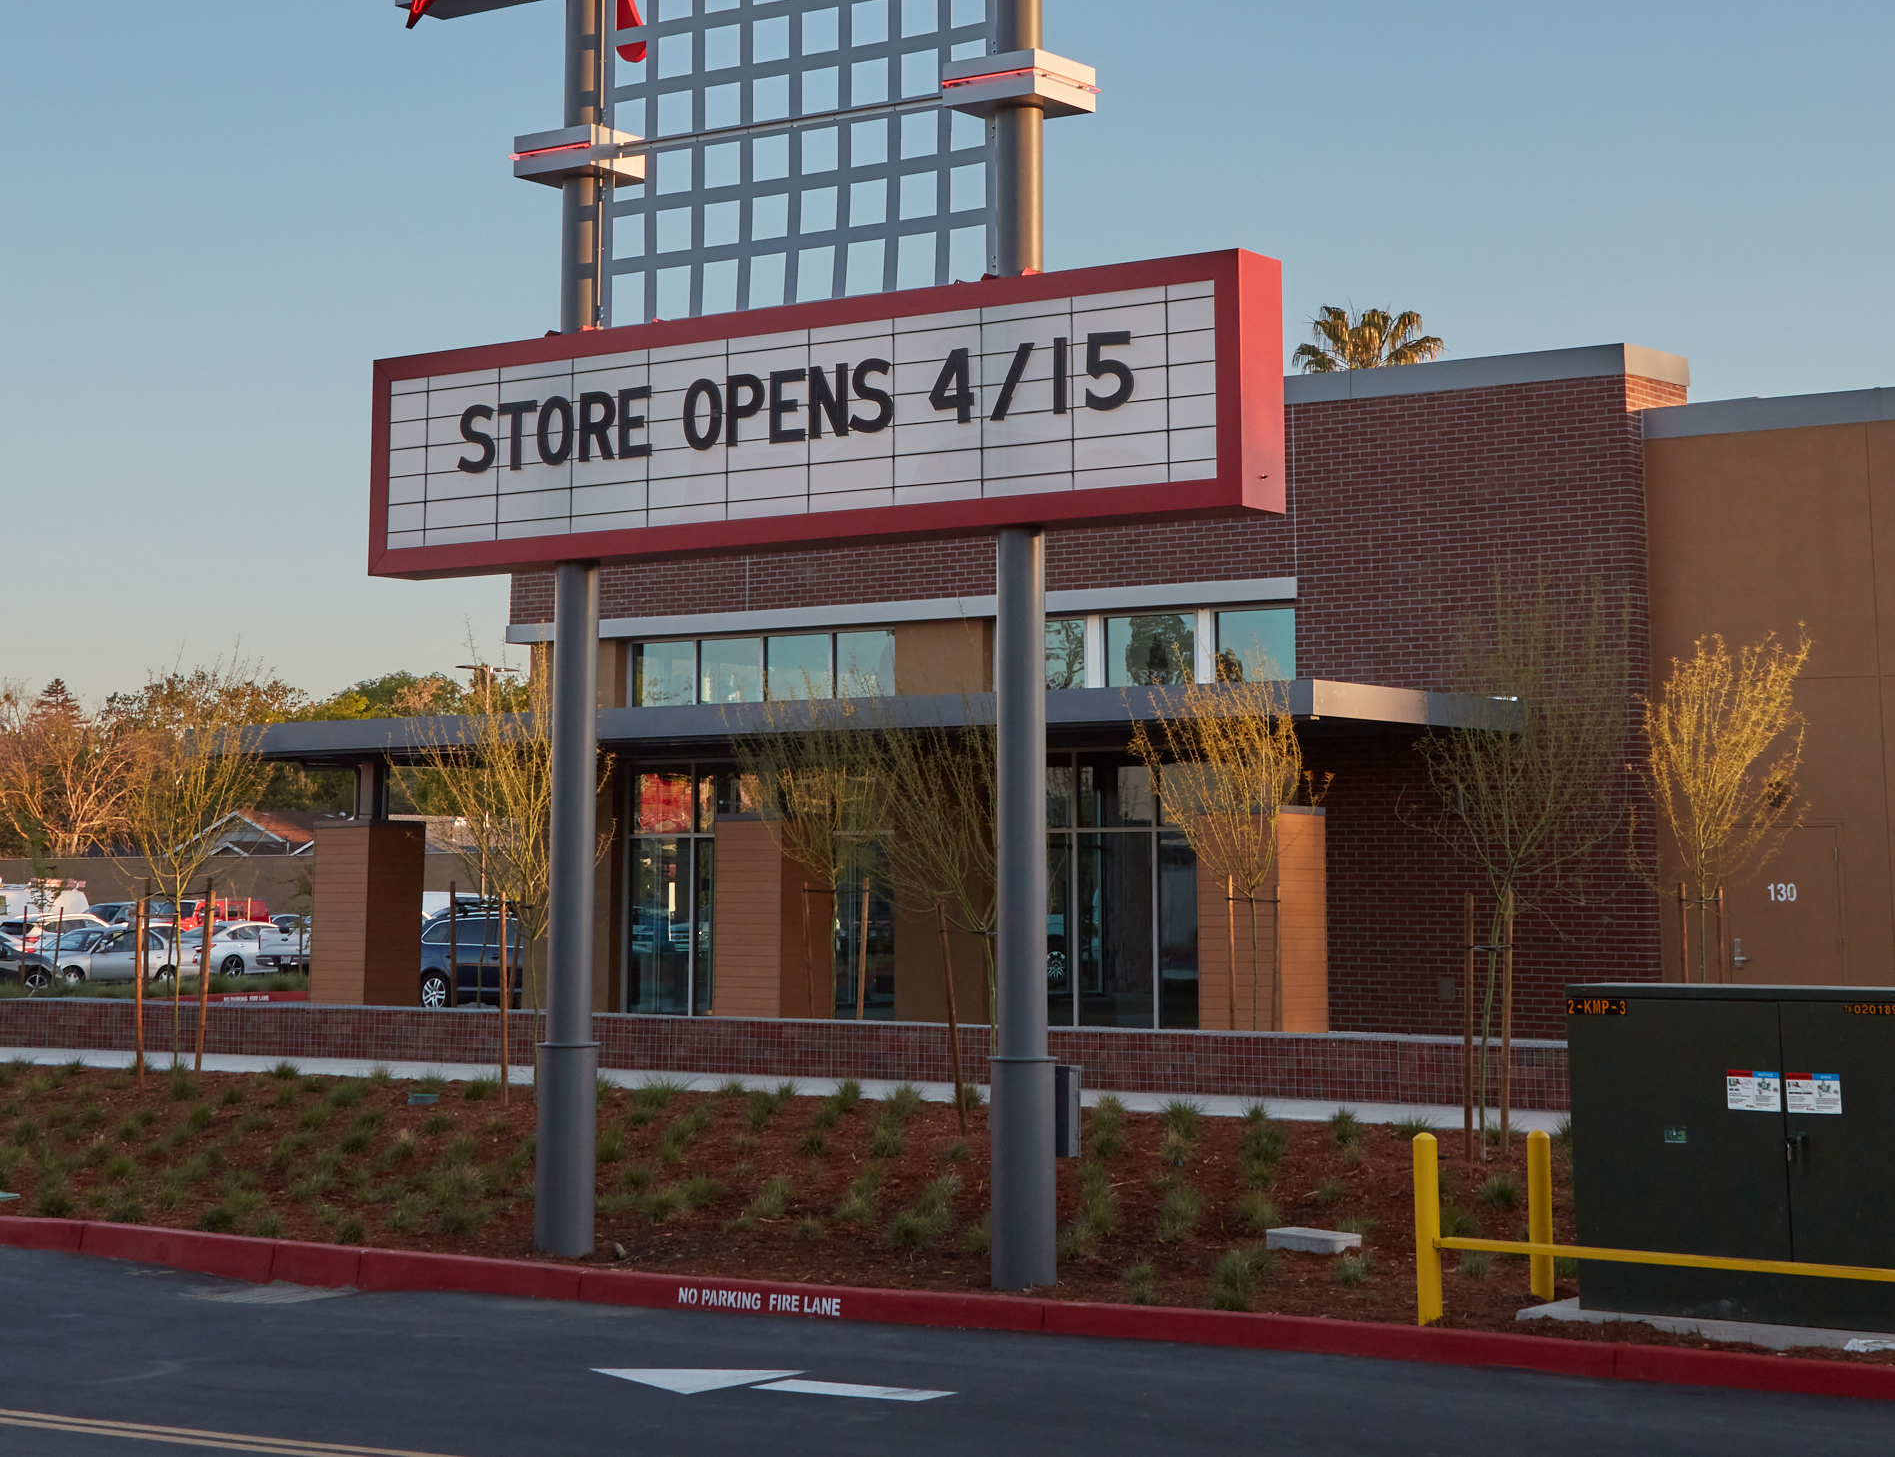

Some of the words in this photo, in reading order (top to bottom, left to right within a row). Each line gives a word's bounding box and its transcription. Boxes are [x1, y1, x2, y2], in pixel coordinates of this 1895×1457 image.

[457, 385, 653, 474] STORE
[683, 357, 894, 451] OPENS
[928, 330, 1135, 424] 4/15
[1767, 883, 1797, 902] 130
[1567, 999, 1626, 1015] 2-KMP-3
[678, 1286, 698, 1305] NO
[701, 1288, 761, 1311] PARKING
[768, 1293, 800, 1313] FIRE
[803, 1295, 841, 1317] LANE
